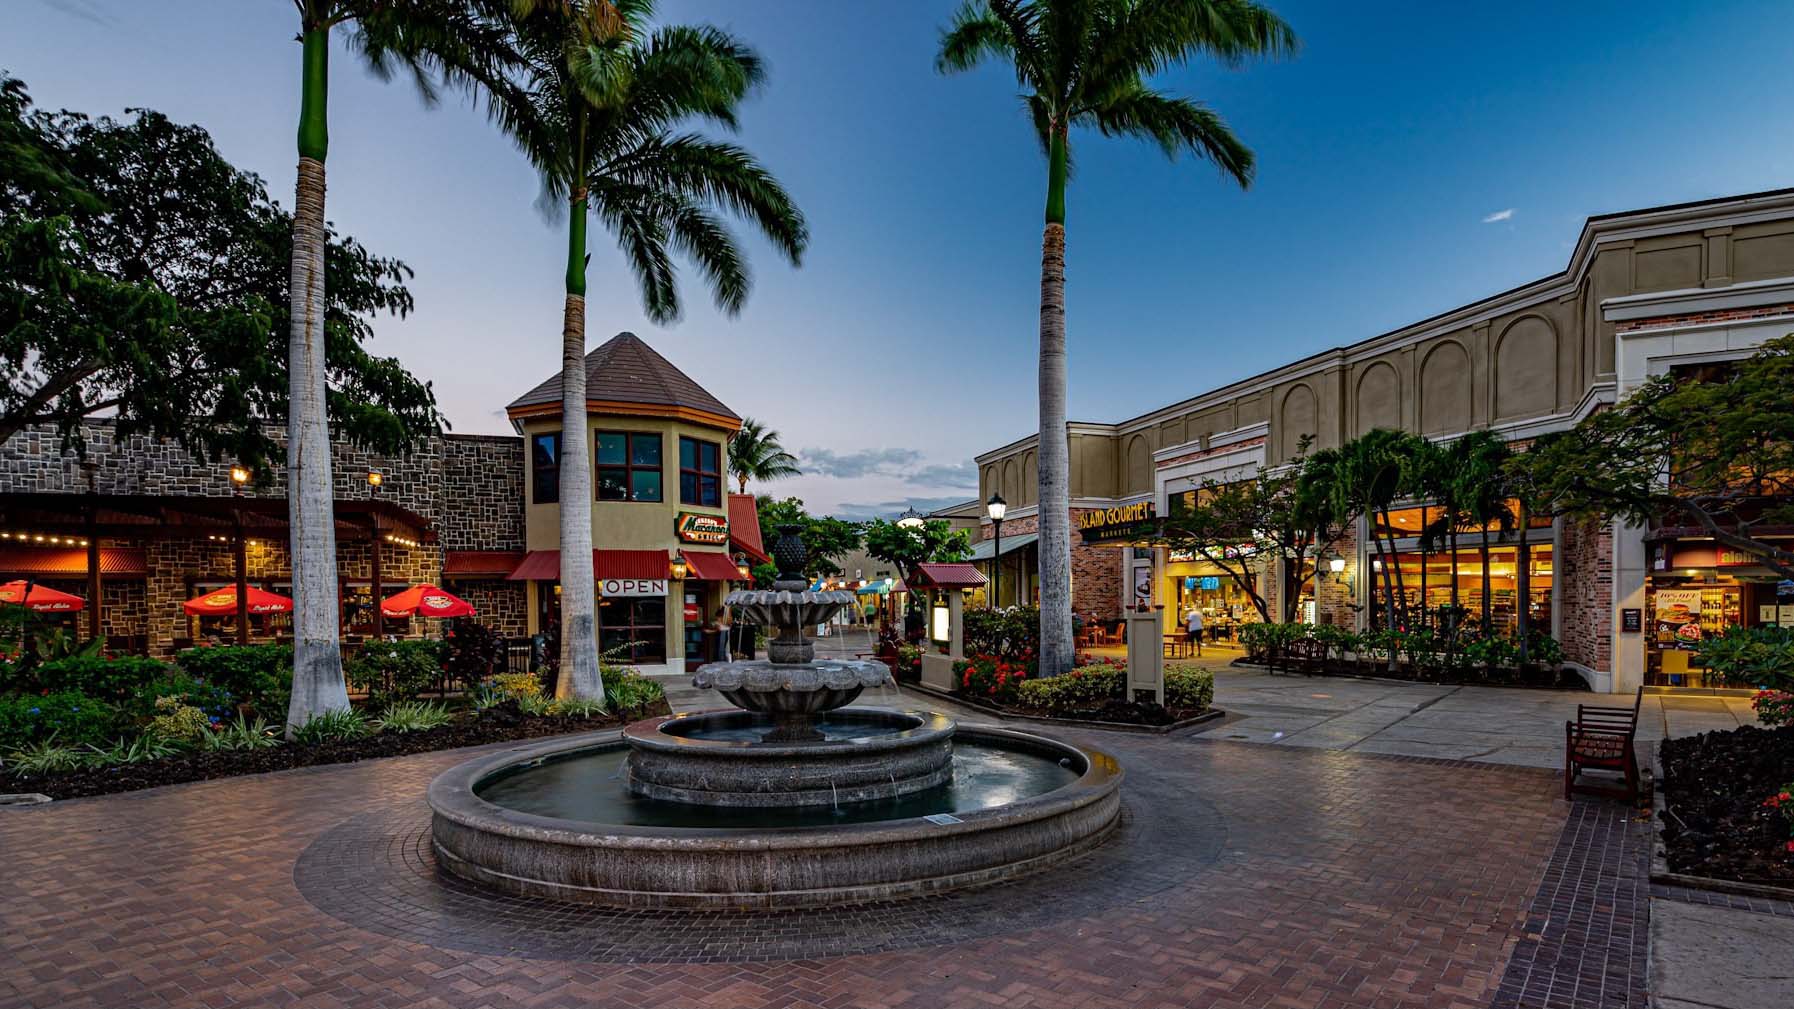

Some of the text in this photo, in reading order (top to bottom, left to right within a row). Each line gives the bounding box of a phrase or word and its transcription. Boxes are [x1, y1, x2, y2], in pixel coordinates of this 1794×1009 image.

[1080, 501, 1149, 528] ISLAND GOURMET
[606, 580, 664, 593] OPEN
